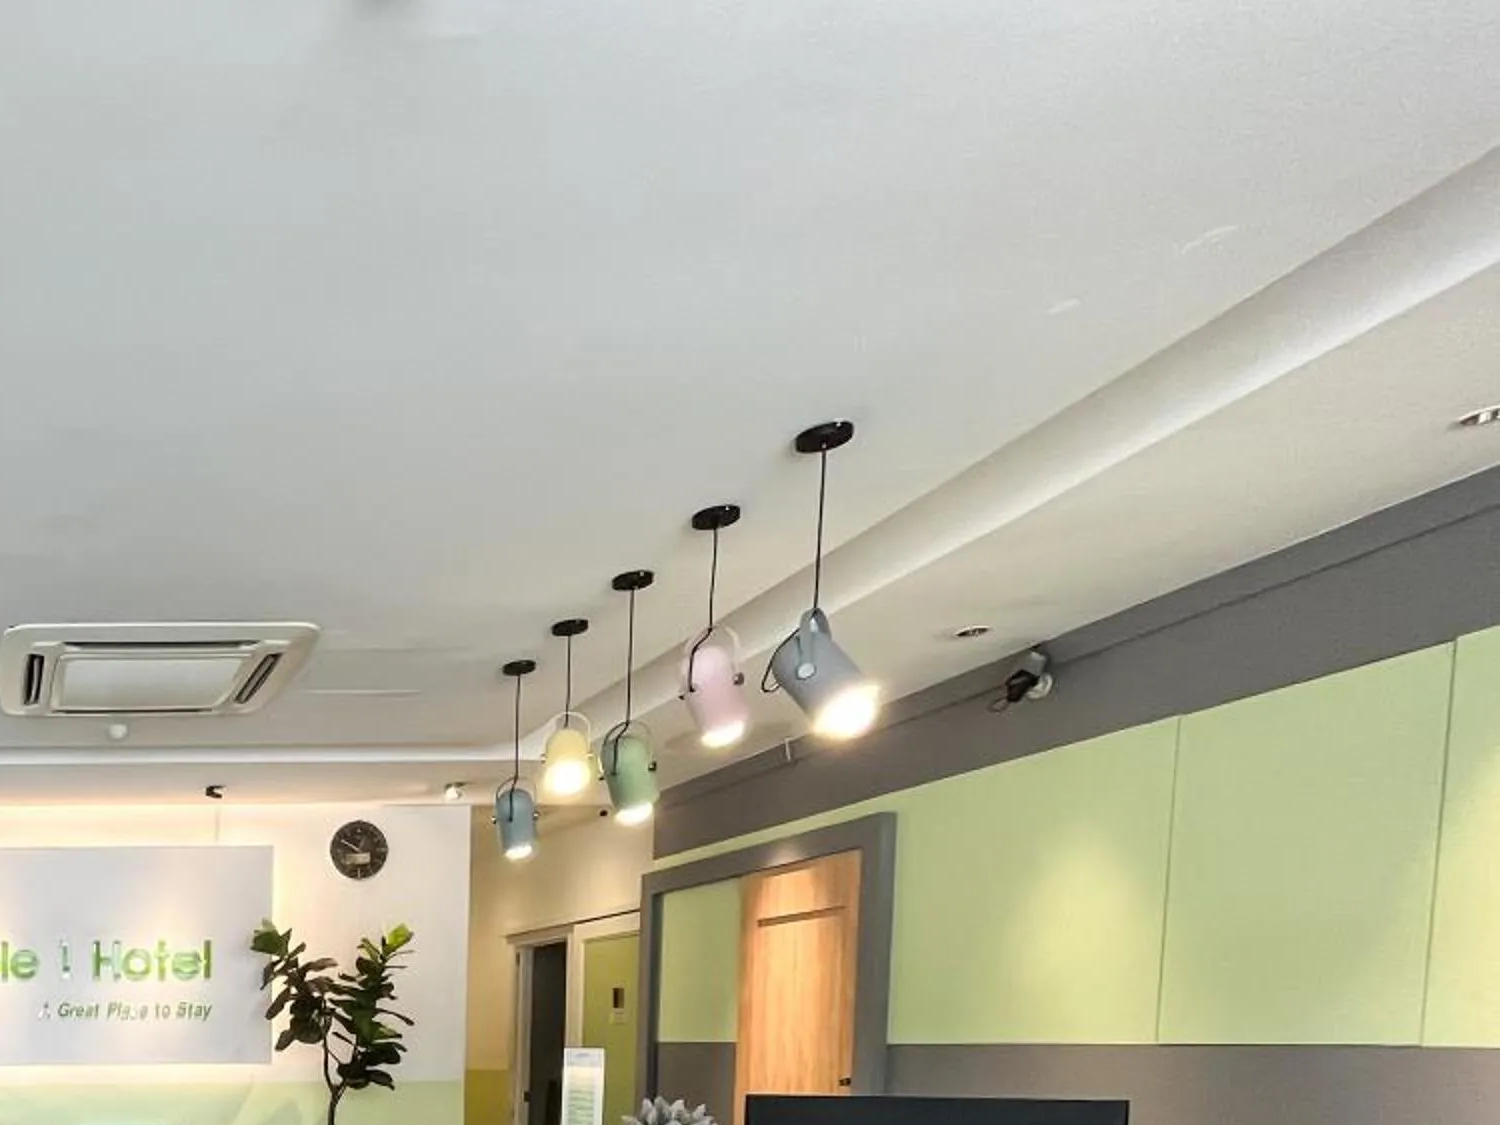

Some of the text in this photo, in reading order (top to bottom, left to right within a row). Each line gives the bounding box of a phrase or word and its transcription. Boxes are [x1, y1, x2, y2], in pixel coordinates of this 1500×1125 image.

[92, 939, 213, 980] Hotel
[57, 1001, 99, 1018] Great
[154, 1002, 171, 1019] to
[175, 1001, 213, 1022] Stay
